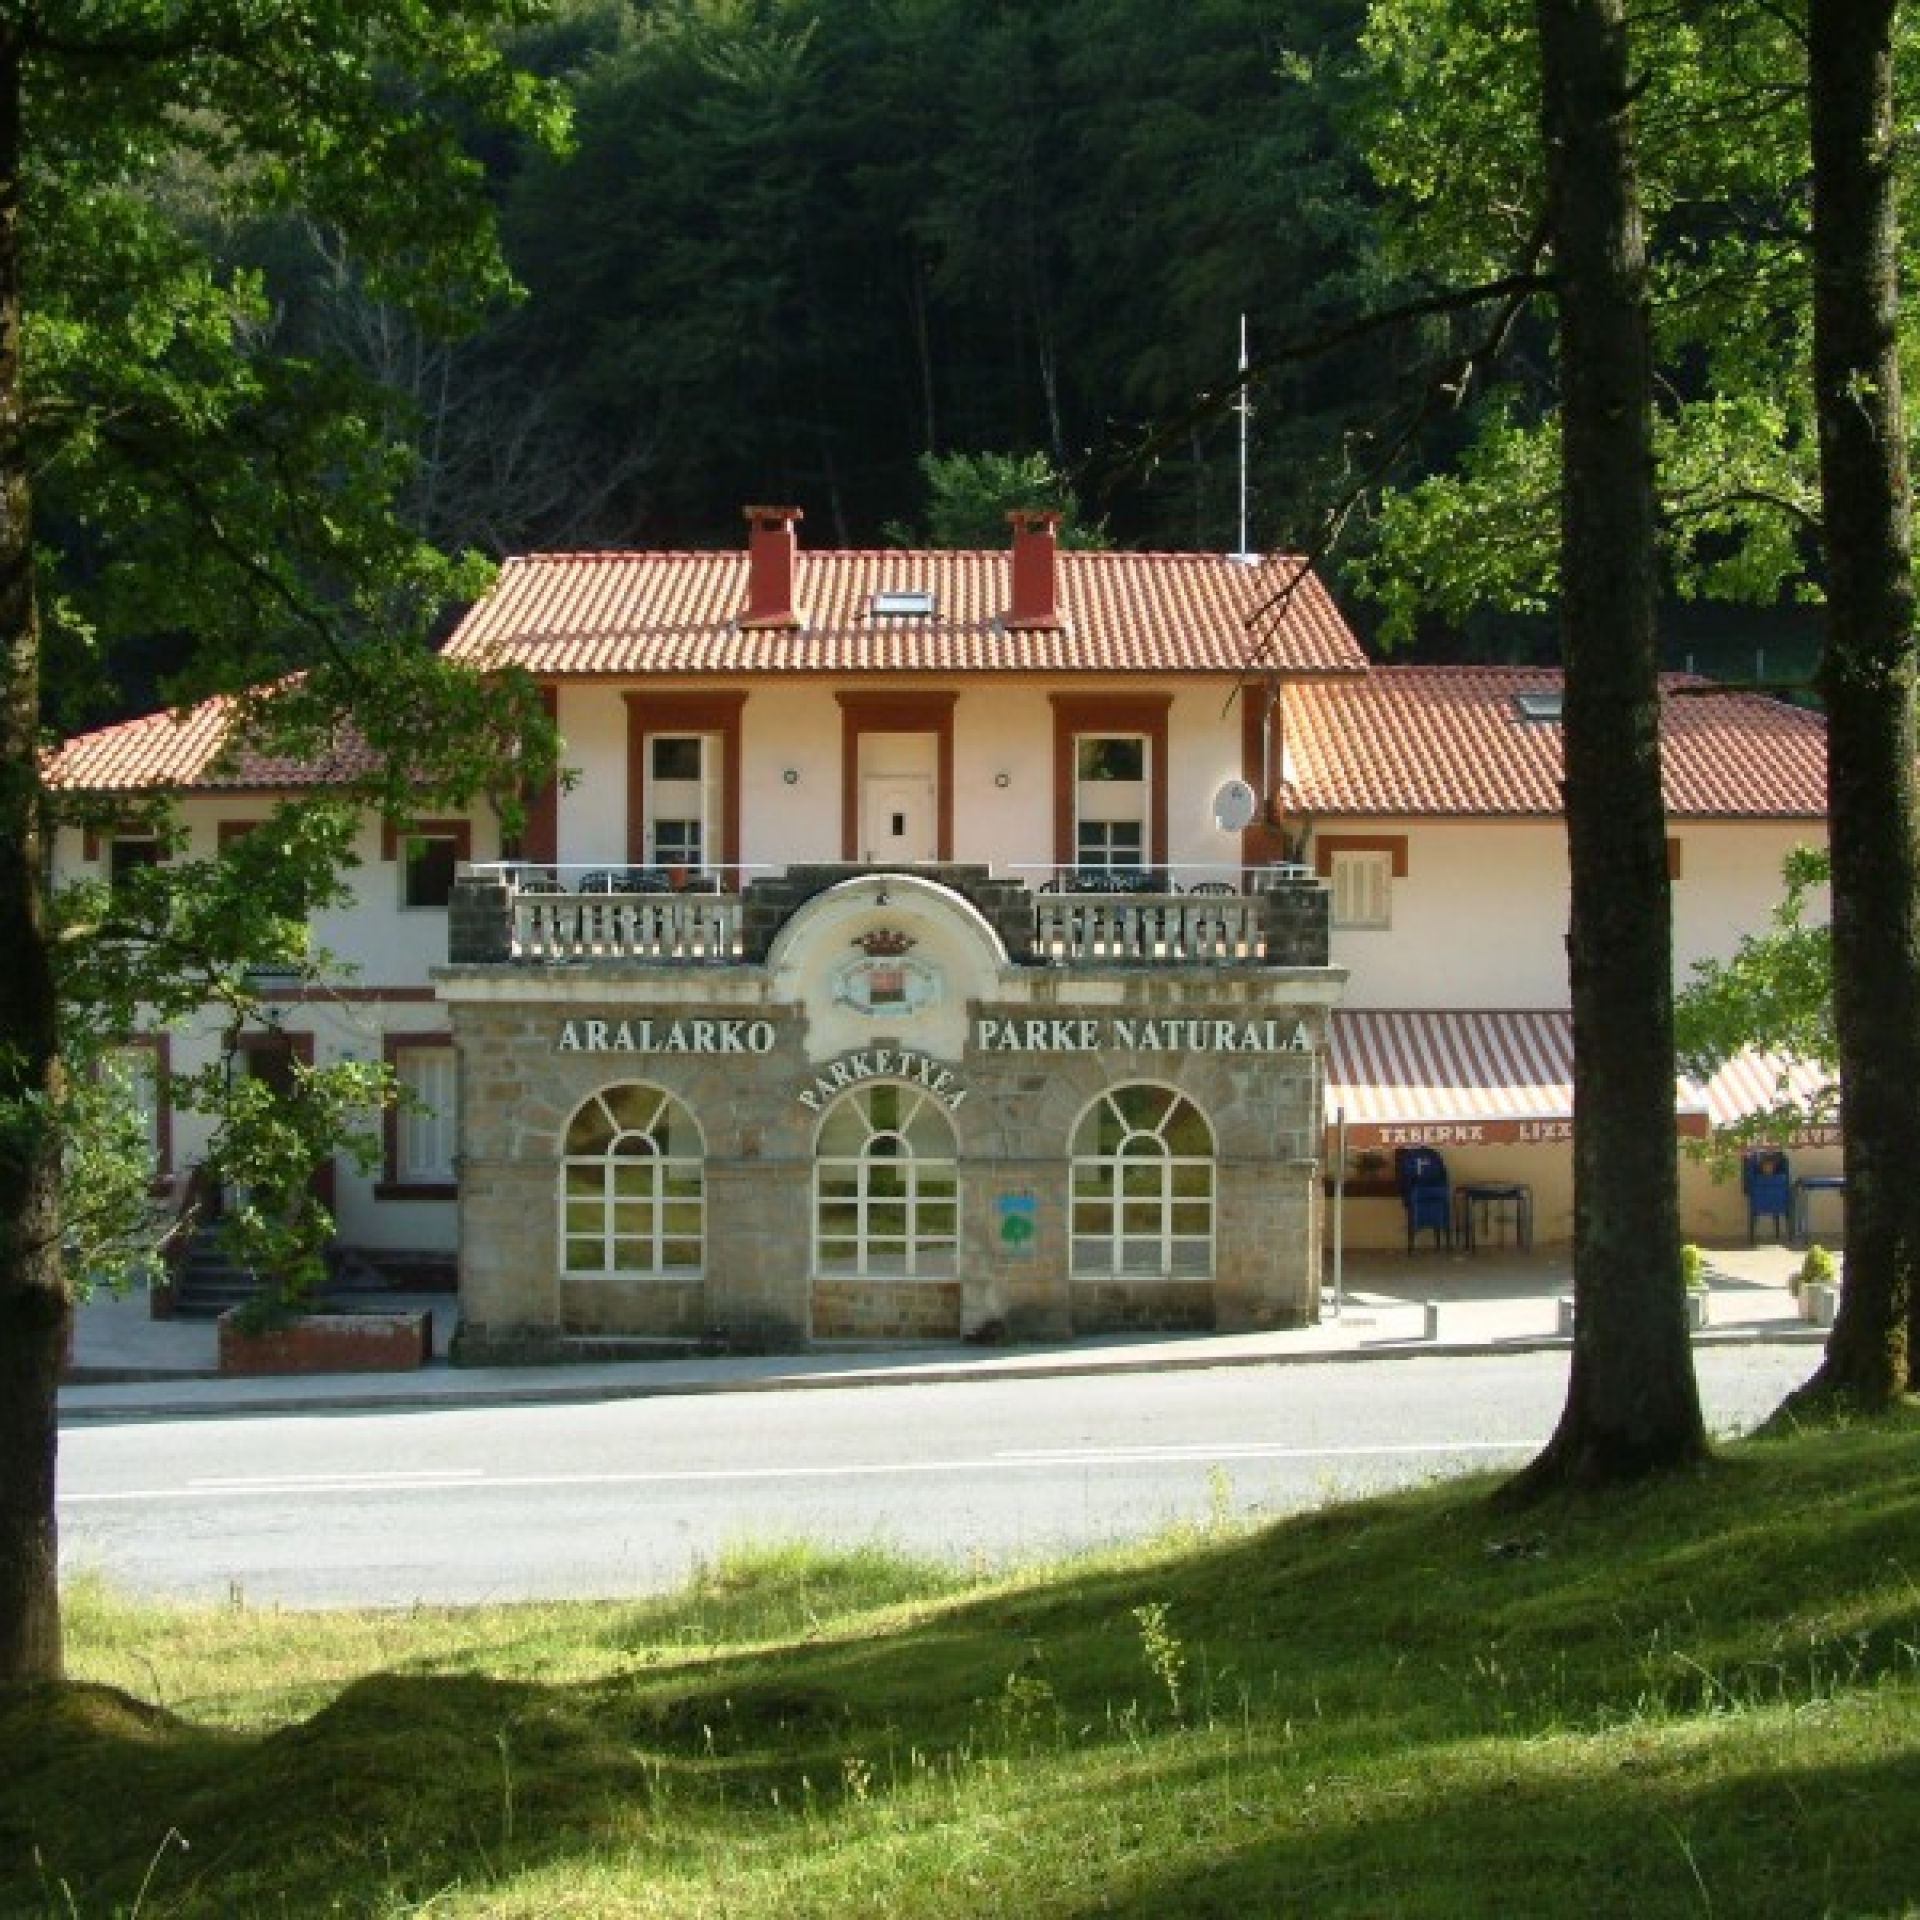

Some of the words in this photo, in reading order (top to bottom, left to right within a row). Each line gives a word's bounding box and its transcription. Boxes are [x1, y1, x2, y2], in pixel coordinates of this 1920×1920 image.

[559, 1019, 776, 1054] ARALARKO
[976, 1019, 1100, 1052] PARKE
[1112, 1019, 1313, 1052] NATURALA
[797, 1048, 968, 1112] PARKETXEA
